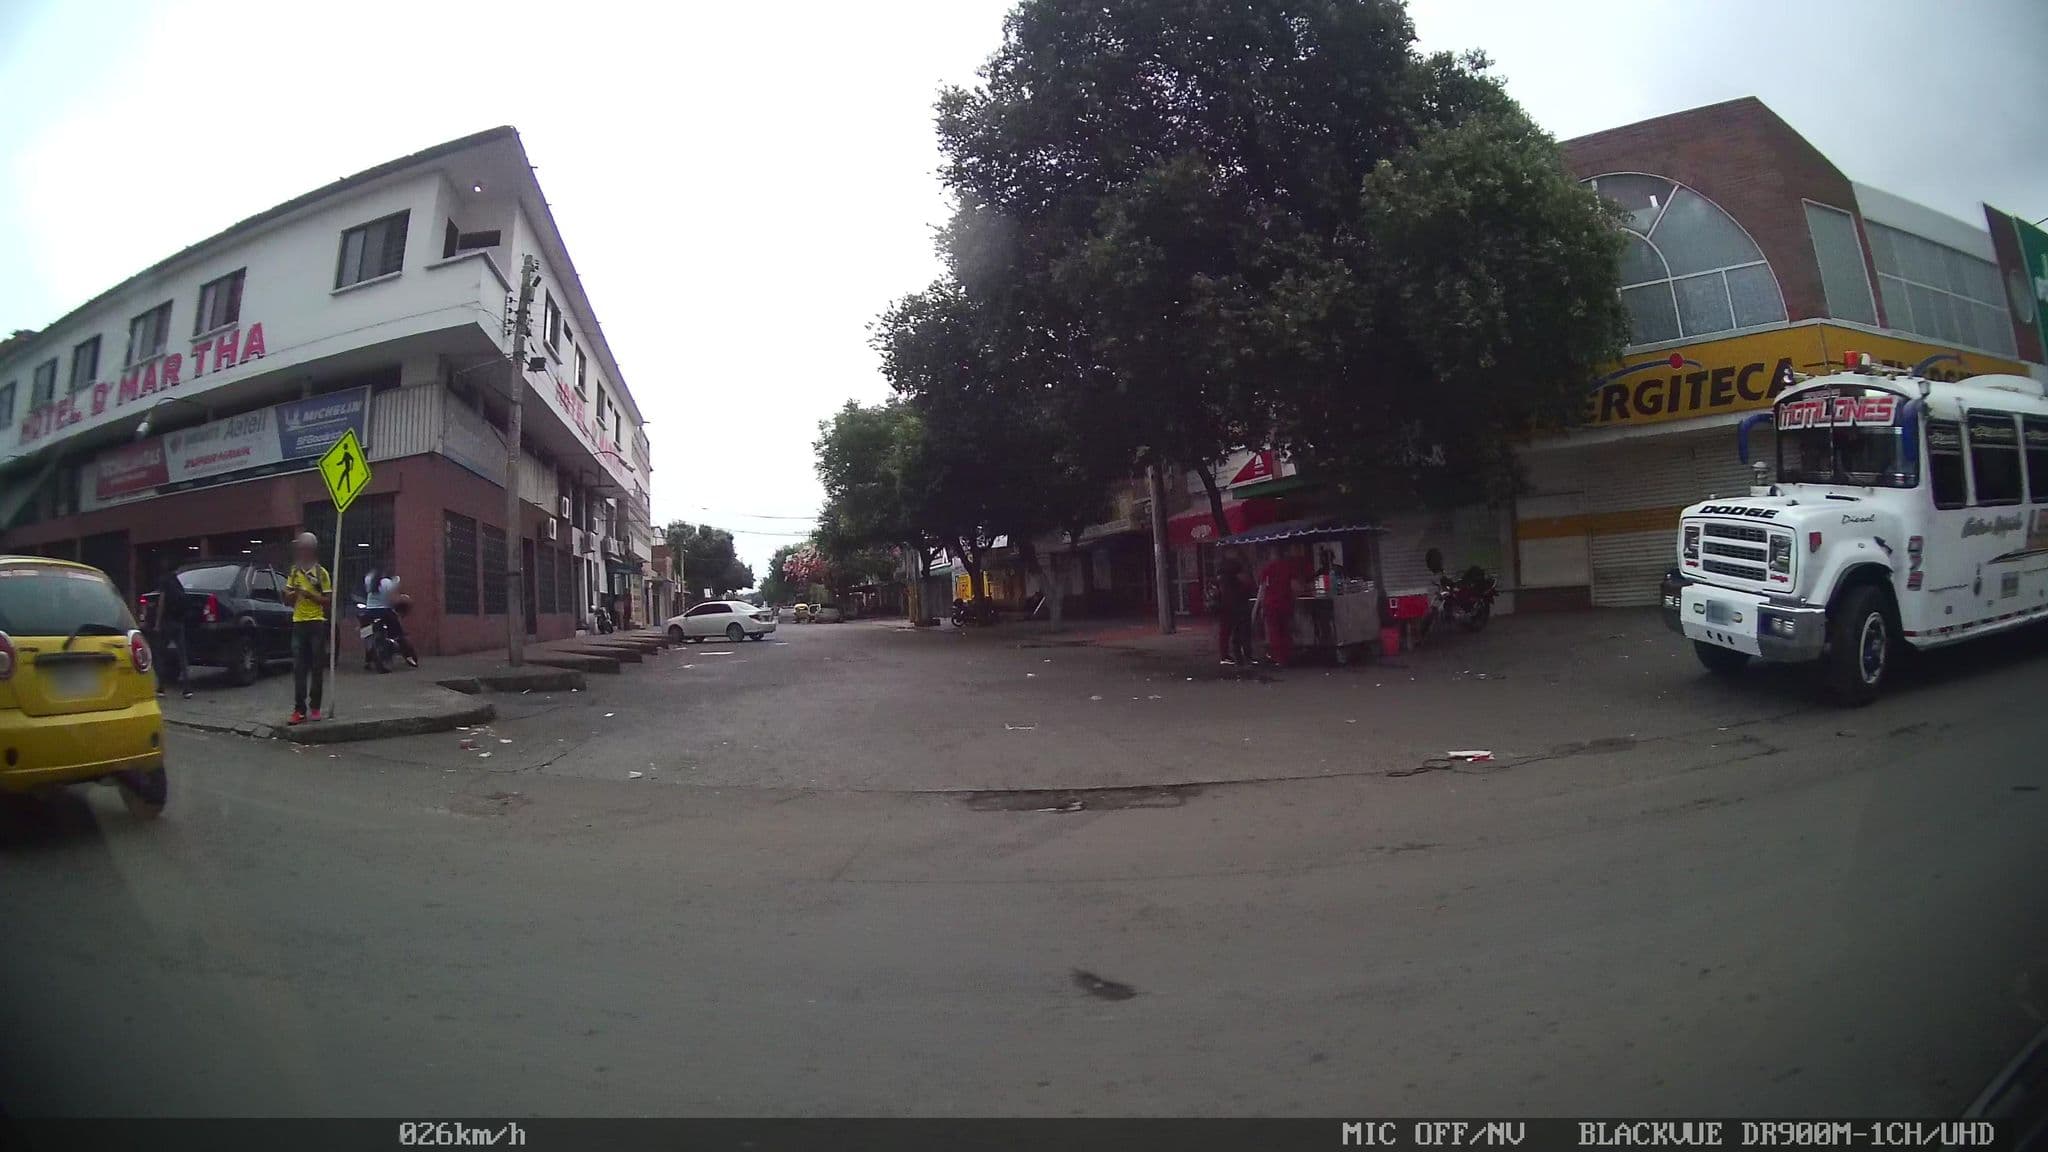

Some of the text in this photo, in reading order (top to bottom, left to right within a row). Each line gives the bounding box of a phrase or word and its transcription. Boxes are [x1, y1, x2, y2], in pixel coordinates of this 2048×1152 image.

[302, 400, 364, 422] MICHELIN
[1699, 505, 1780, 519] DODGE
[1841, 514, 1875, 524] Diesel
